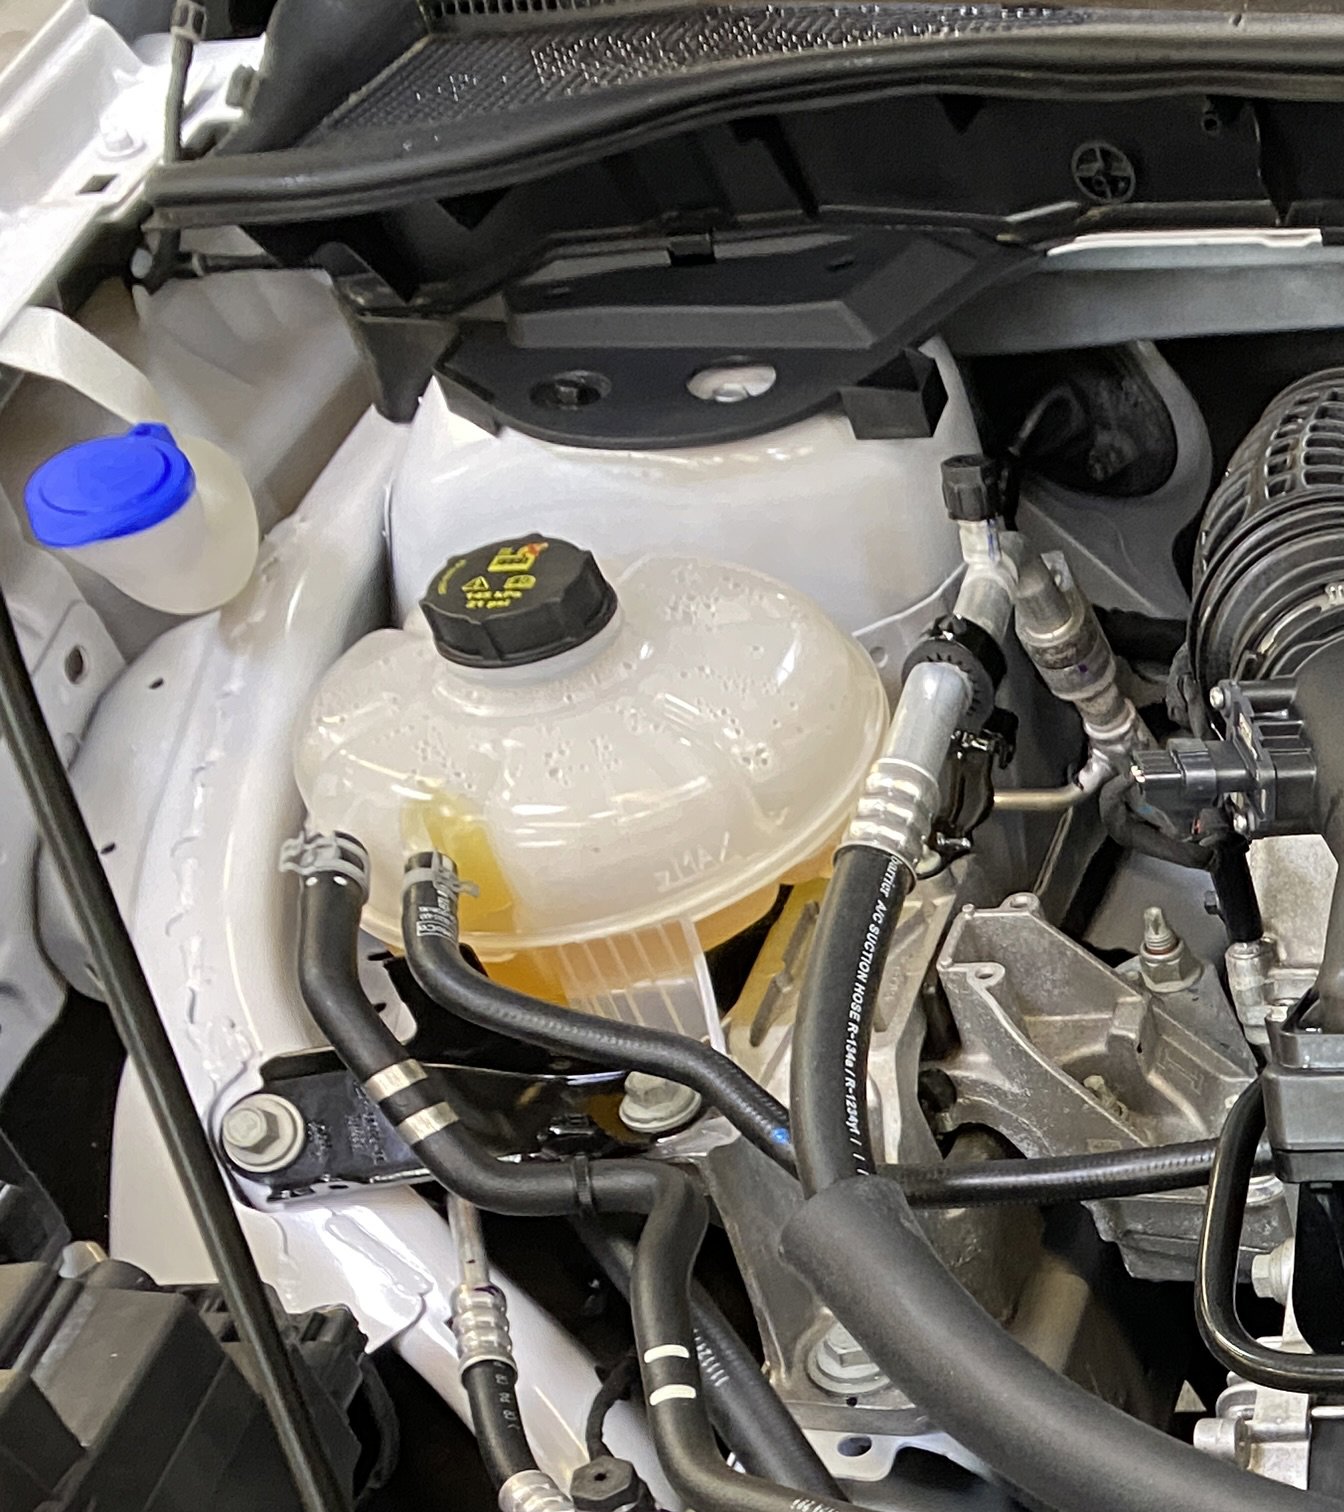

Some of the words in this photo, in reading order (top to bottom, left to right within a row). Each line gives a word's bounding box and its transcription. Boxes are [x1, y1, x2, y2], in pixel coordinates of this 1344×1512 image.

[872, 899, 888, 925] A/C
[857, 923, 881, 984] SUCTION
[849, 982, 867, 1022] HOSE
[844, 1021, 859, 1068] R-134a
[844, 1076, 861, 1136] R-1234yf
